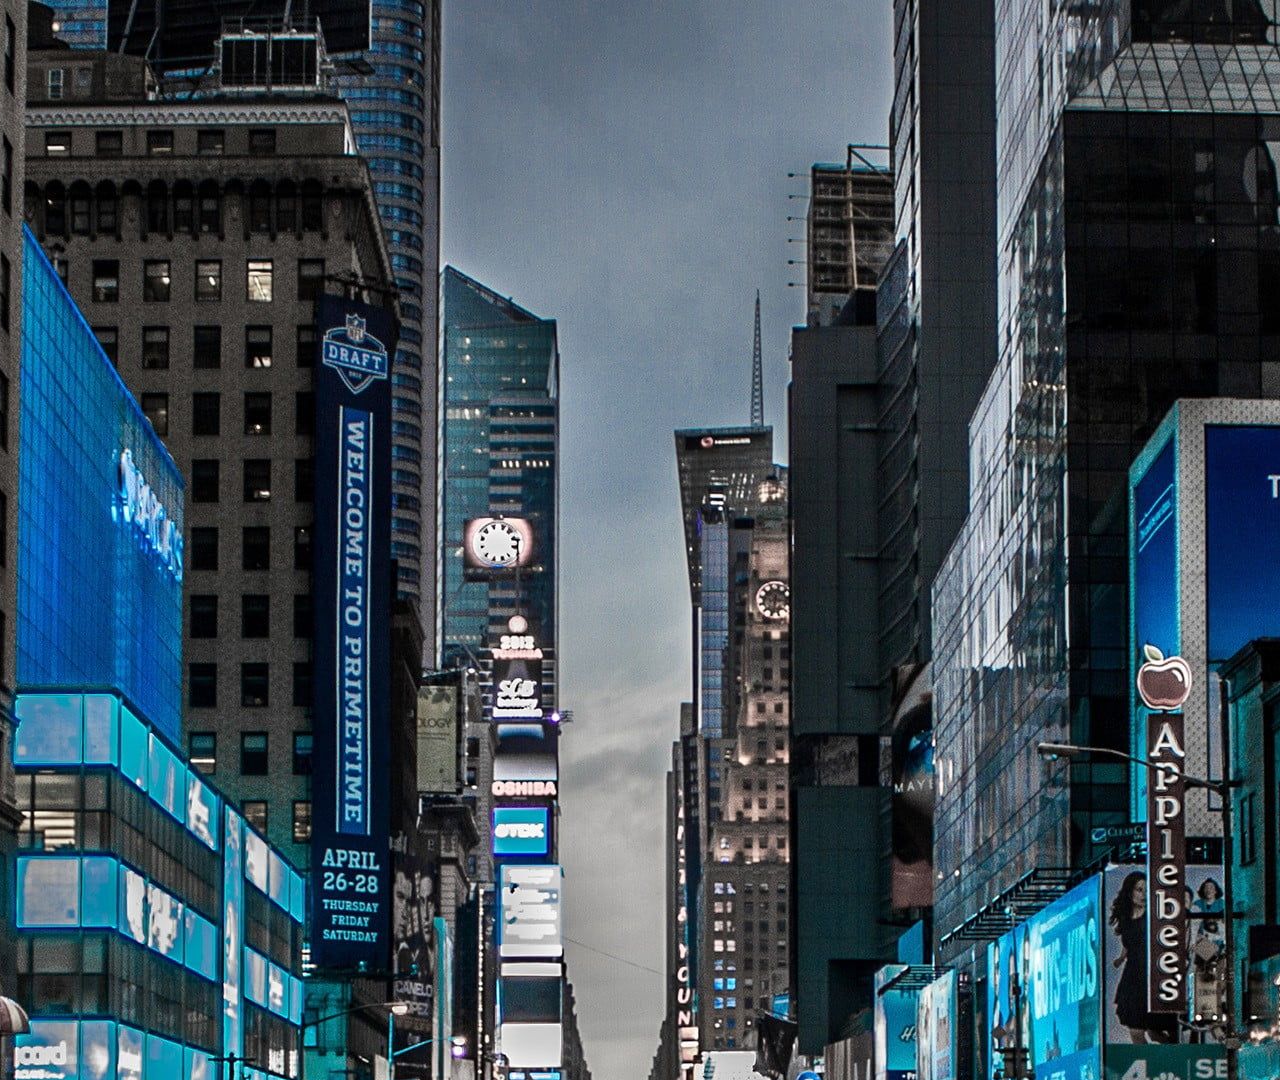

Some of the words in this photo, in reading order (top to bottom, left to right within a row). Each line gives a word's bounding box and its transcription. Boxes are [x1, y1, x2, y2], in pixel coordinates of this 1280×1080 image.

[328, 344, 382, 370] DRAFT
[346, 419, 365, 578] WELCOME
[344, 586, 363, 628] TO
[344, 634, 363, 824] PRIMETIME
[491, 781, 557, 796] OSHIBA
[322, 848, 380, 870] APRIL
[1150, 722, 1186, 1002] Applebee's
[323, 872, 379, 894] 26-28
[322, 898, 380, 913] THURSDAY
[331, 915, 370, 927] FRIDAY
[322, 929, 379, 943] SATURDAY
